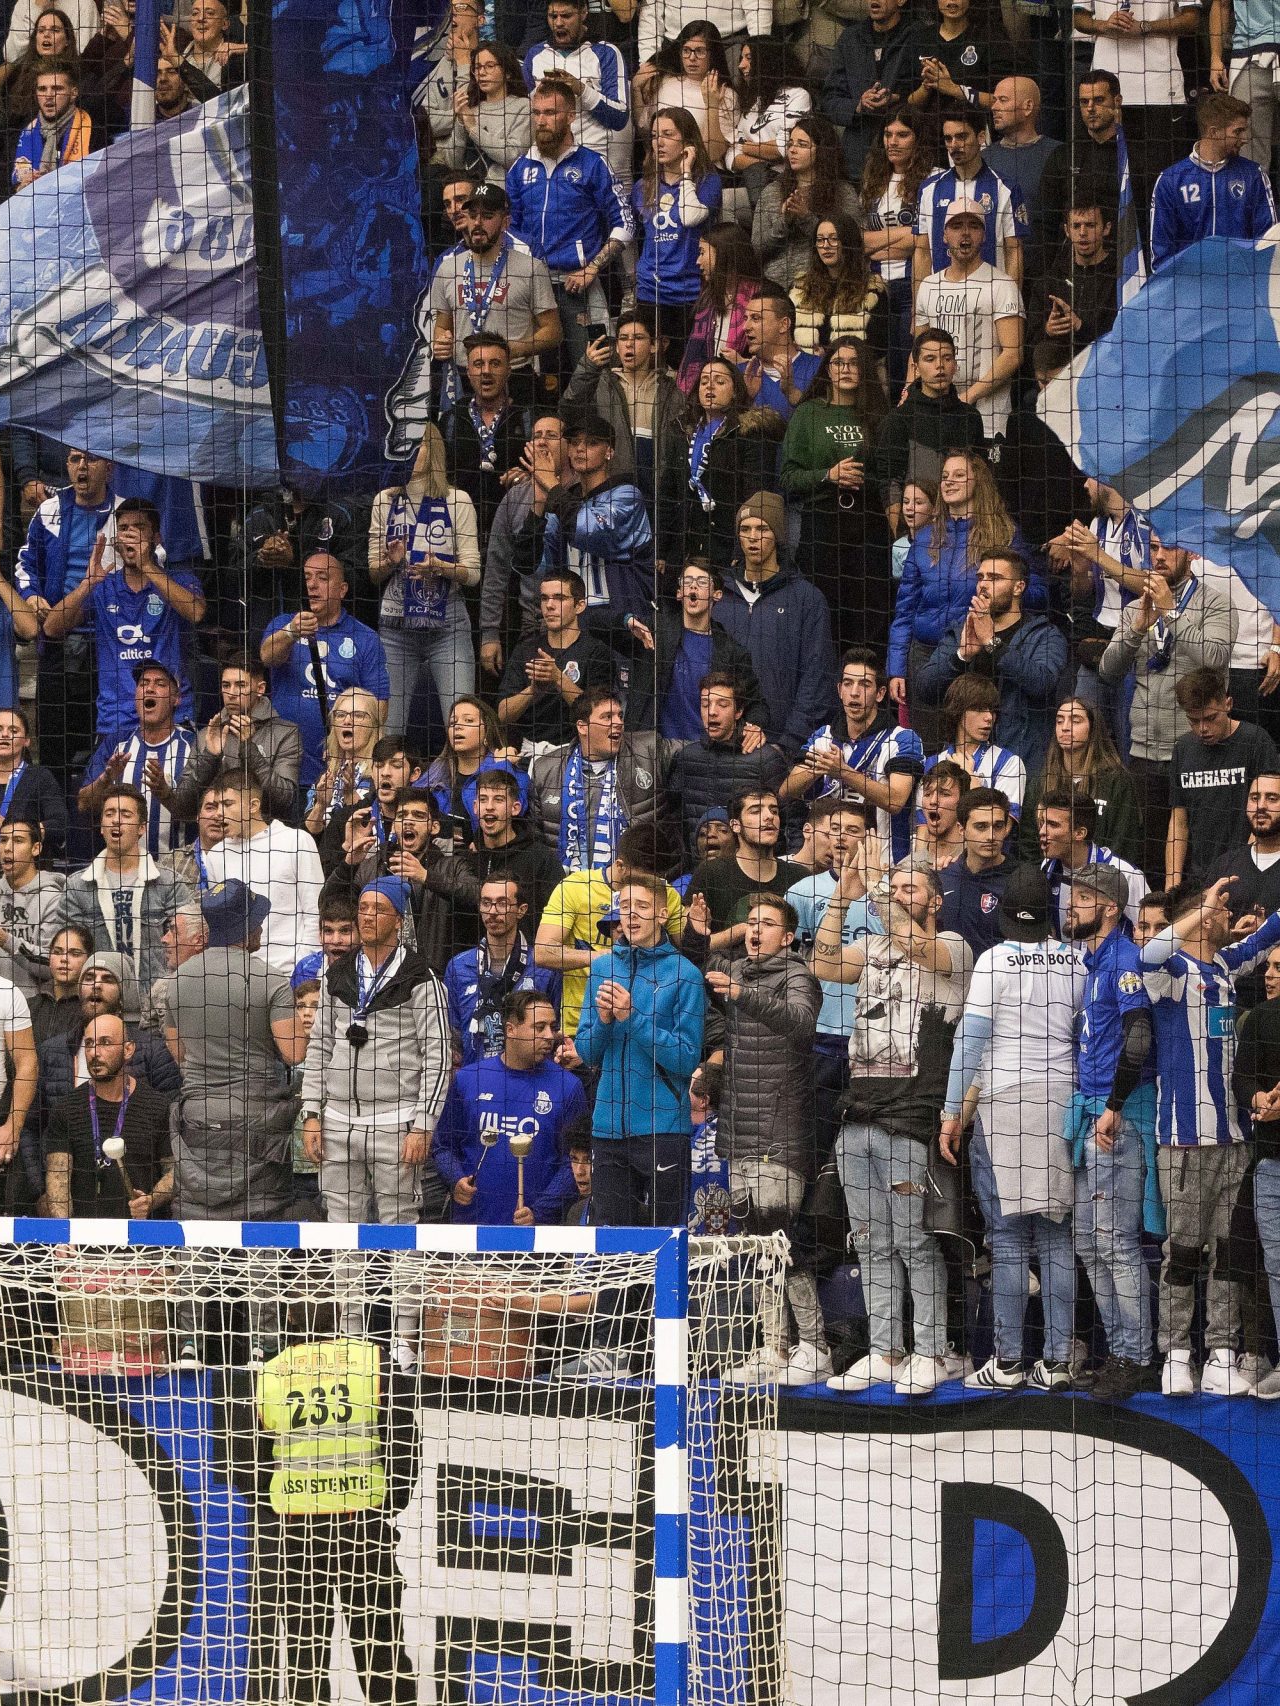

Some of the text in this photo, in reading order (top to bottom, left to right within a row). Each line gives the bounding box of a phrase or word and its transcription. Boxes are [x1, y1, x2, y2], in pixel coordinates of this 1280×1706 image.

[1180, 183, 1200, 203] 12
[936, 294, 967, 314] COM
[825, 424, 863, 435] KYOT
[119, 648, 153, 661] altice
[301, 688, 337, 701] alte
[1180, 767, 1246, 789] CARHARTT
[1006, 953, 1082, 968] SUPER BOCK
[285, 1383, 353, 1429] 233
[281, 1473, 369, 1495] ASSISTENTE
